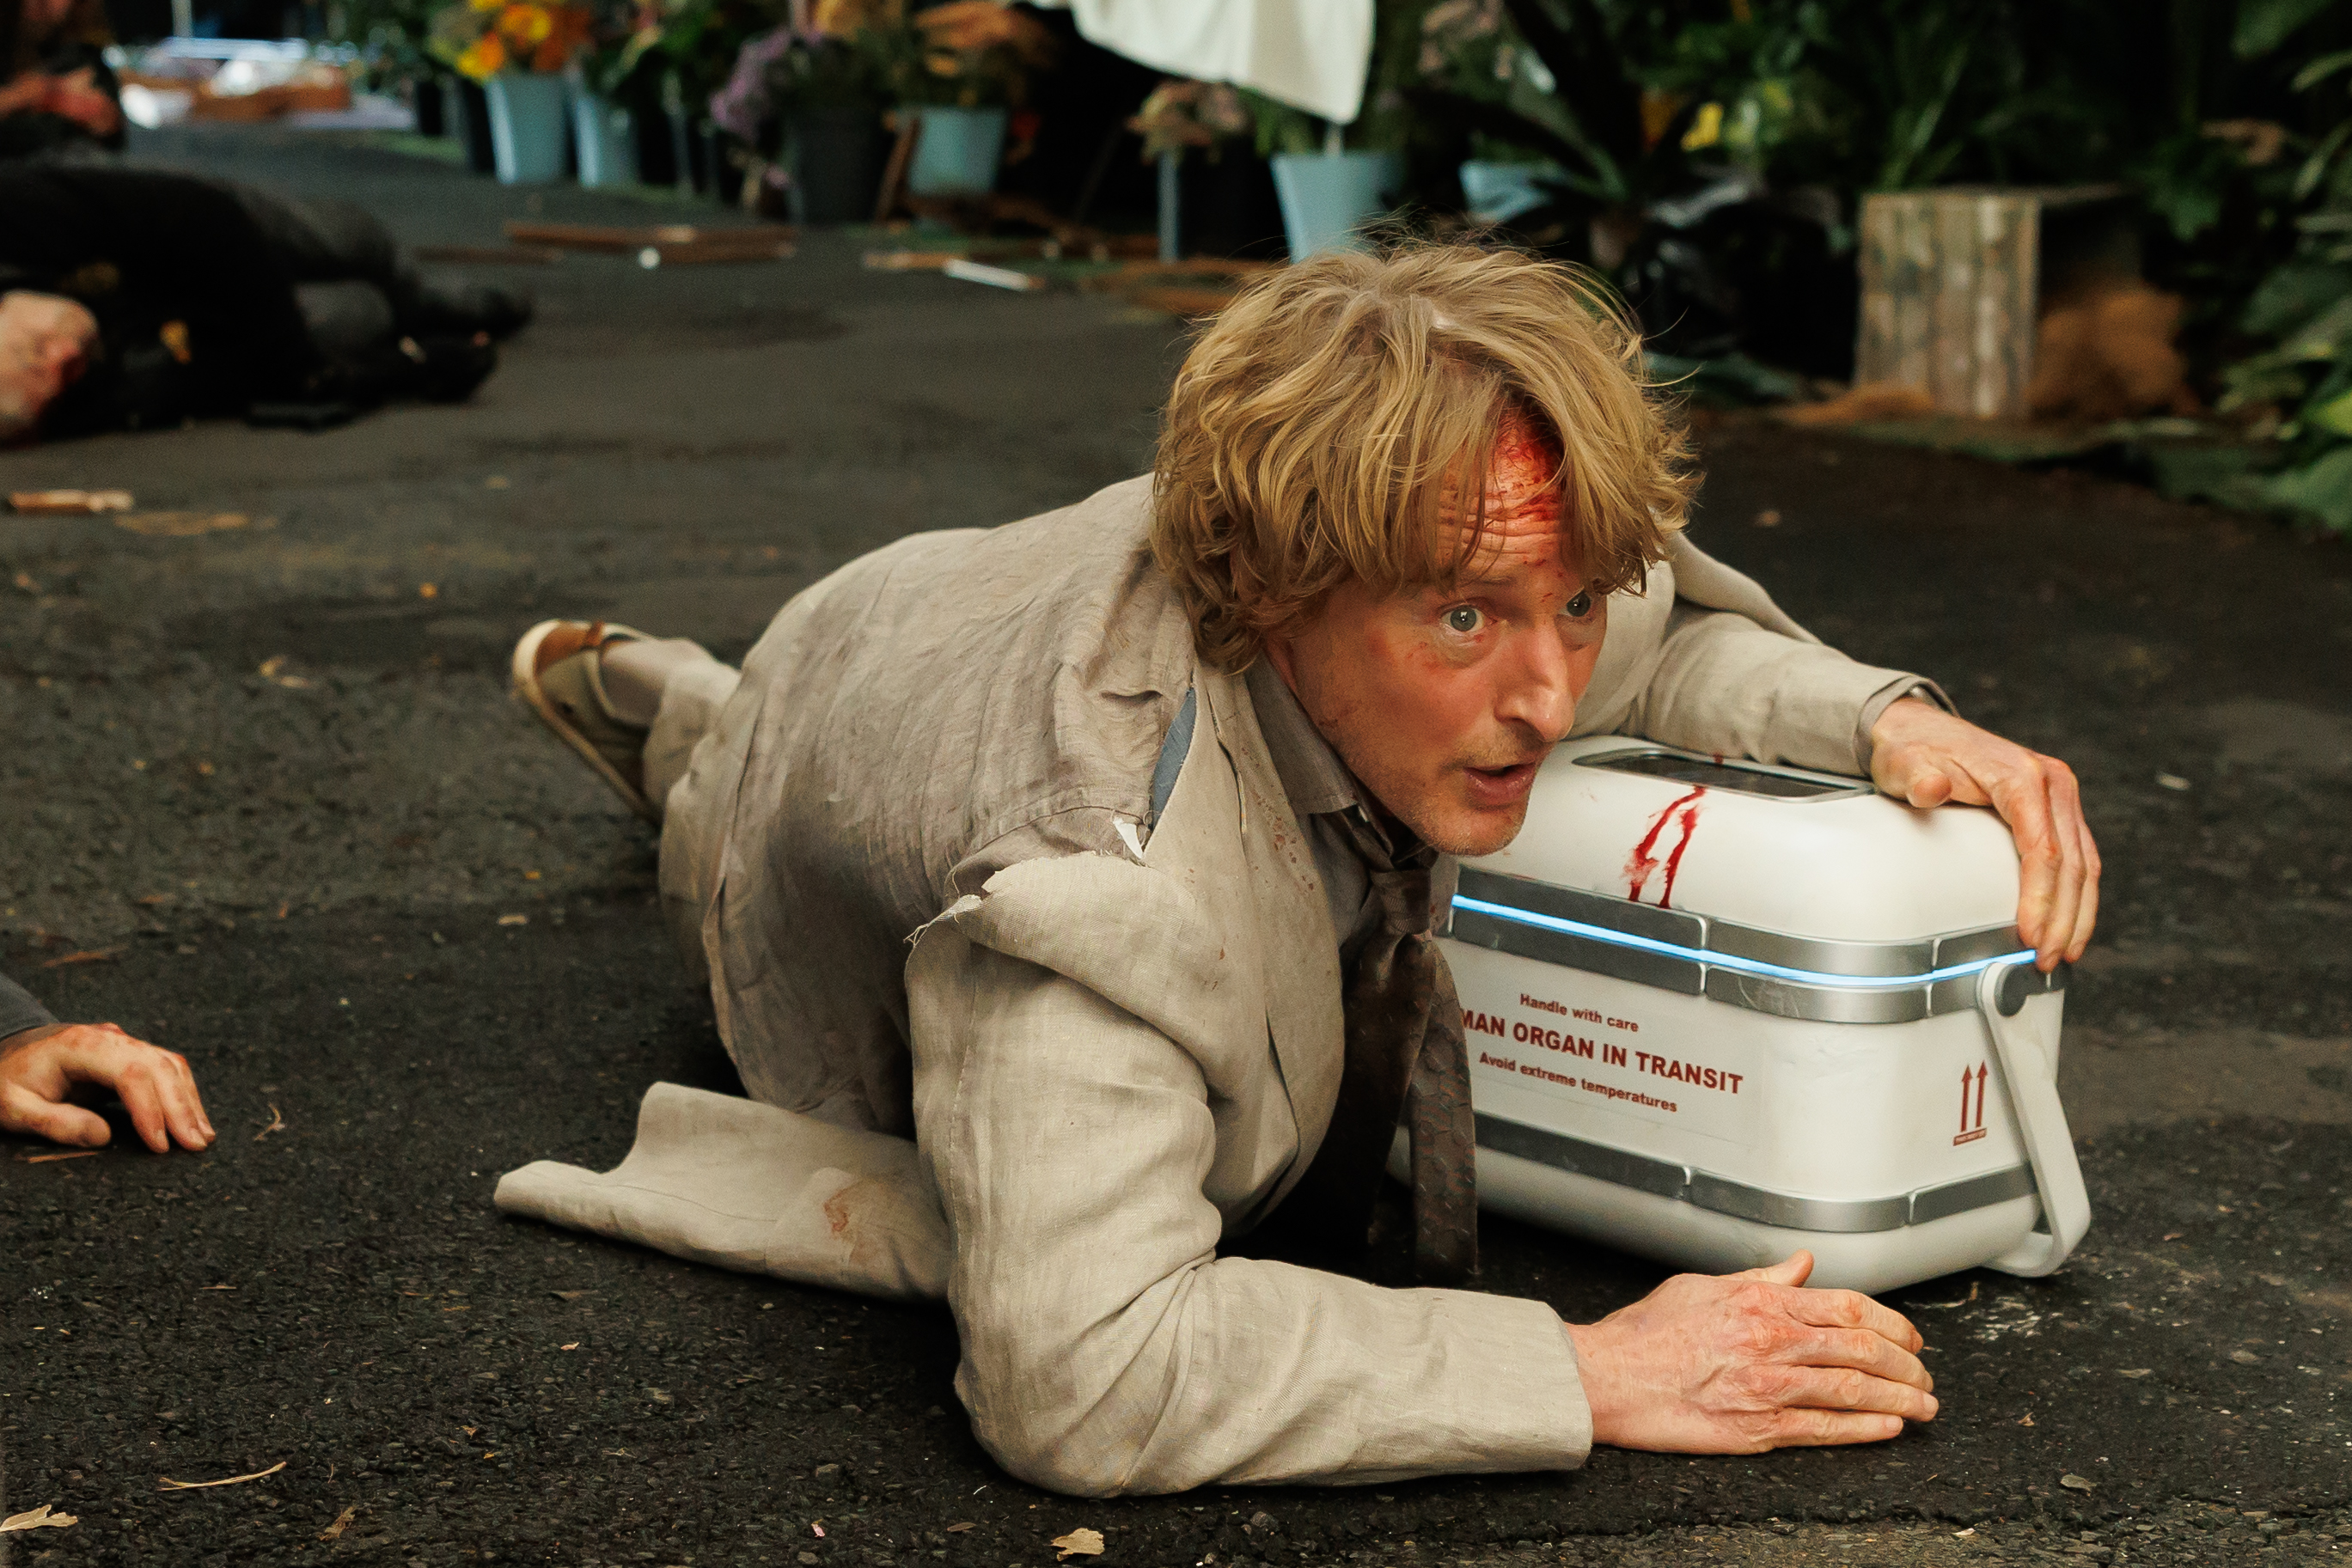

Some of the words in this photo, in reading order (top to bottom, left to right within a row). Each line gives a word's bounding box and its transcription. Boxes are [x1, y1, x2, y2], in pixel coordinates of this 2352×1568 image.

[1520, 993, 1567, 1016] Handle
[1572, 1008, 1602, 1024] with
[1606, 1018, 1639, 1032] care
[1479, 1052, 1516, 1071] Avoid
[1519, 1065, 1577, 1087] extreme
[1581, 1077, 1677, 1113] temperatures
[1512, 1022, 1595, 1059] ORGAN
[1602, 1043, 1628, 1067] IN
[1635, 1051, 1744, 1095] TRANSIT
